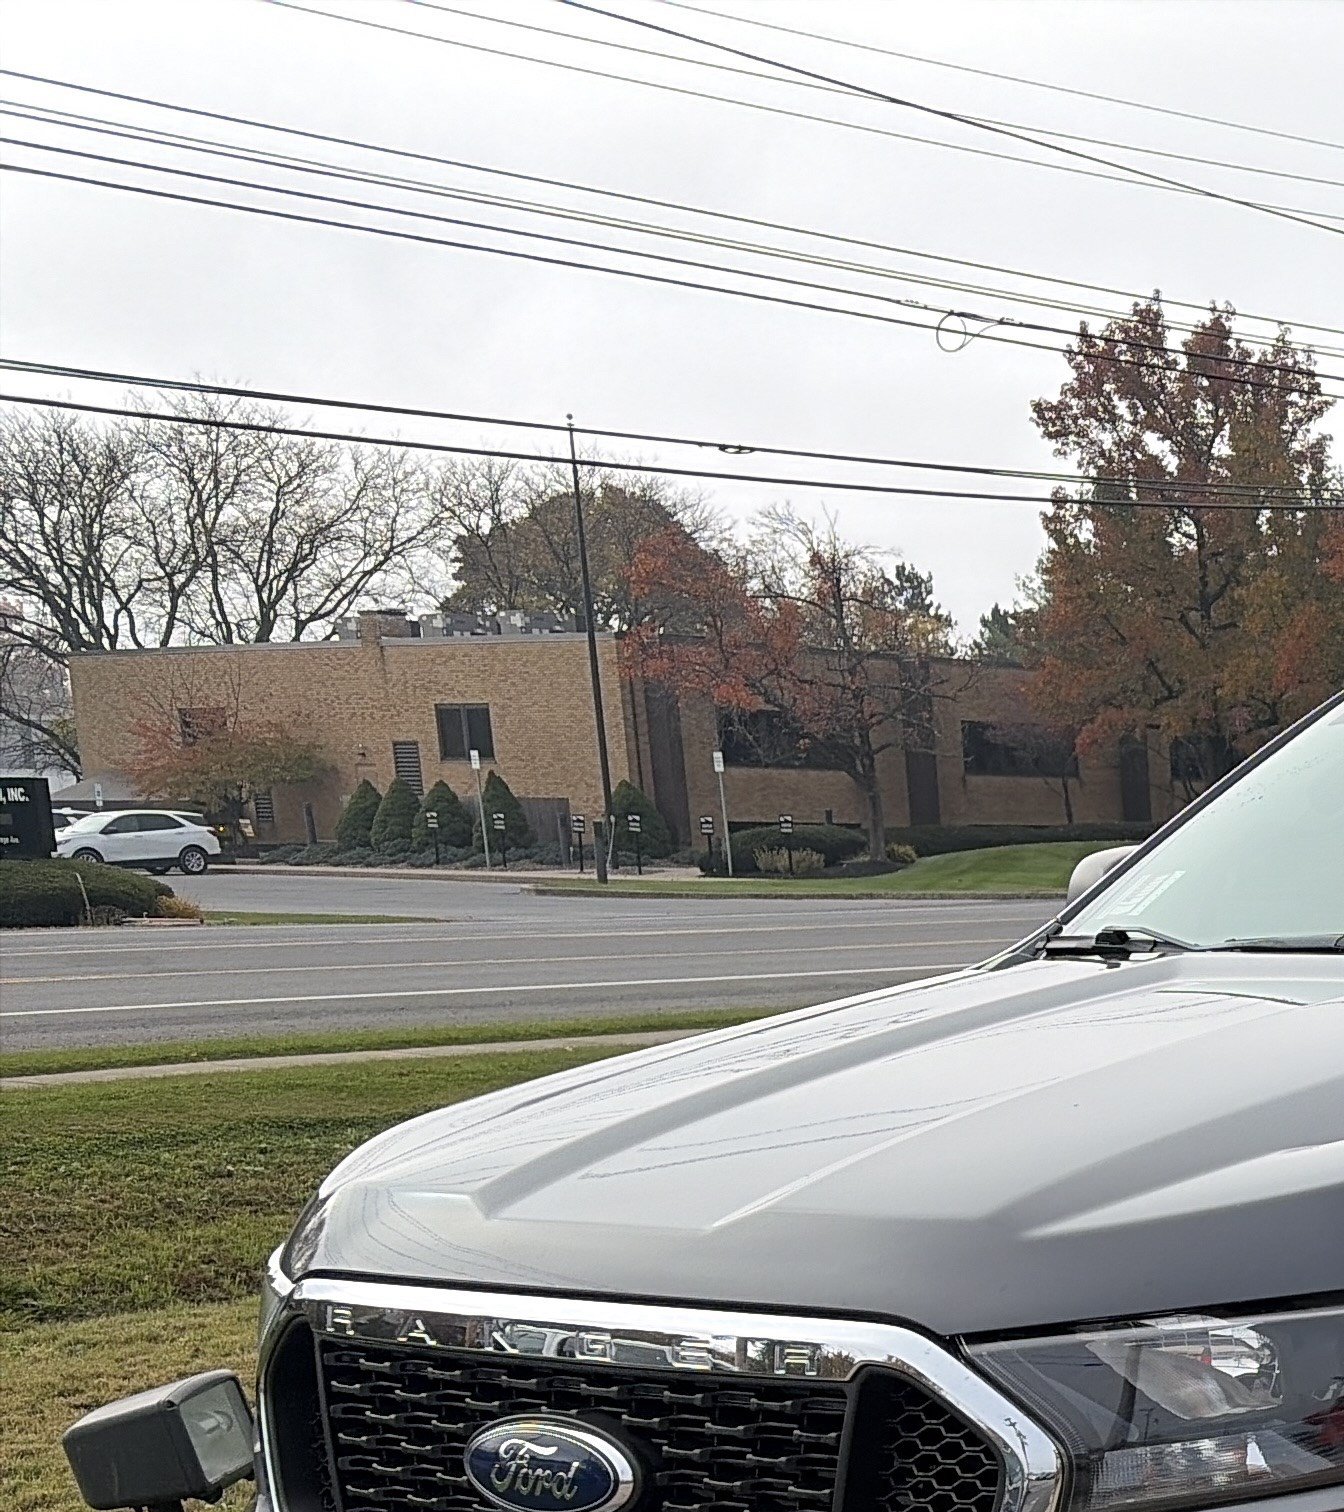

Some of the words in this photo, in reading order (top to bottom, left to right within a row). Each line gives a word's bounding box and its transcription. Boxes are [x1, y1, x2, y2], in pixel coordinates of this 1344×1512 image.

[6, 787, 29, 801] INC.
[324, 1303, 818, 1376] RANGER
[490, 1438, 580, 1501] Ford
